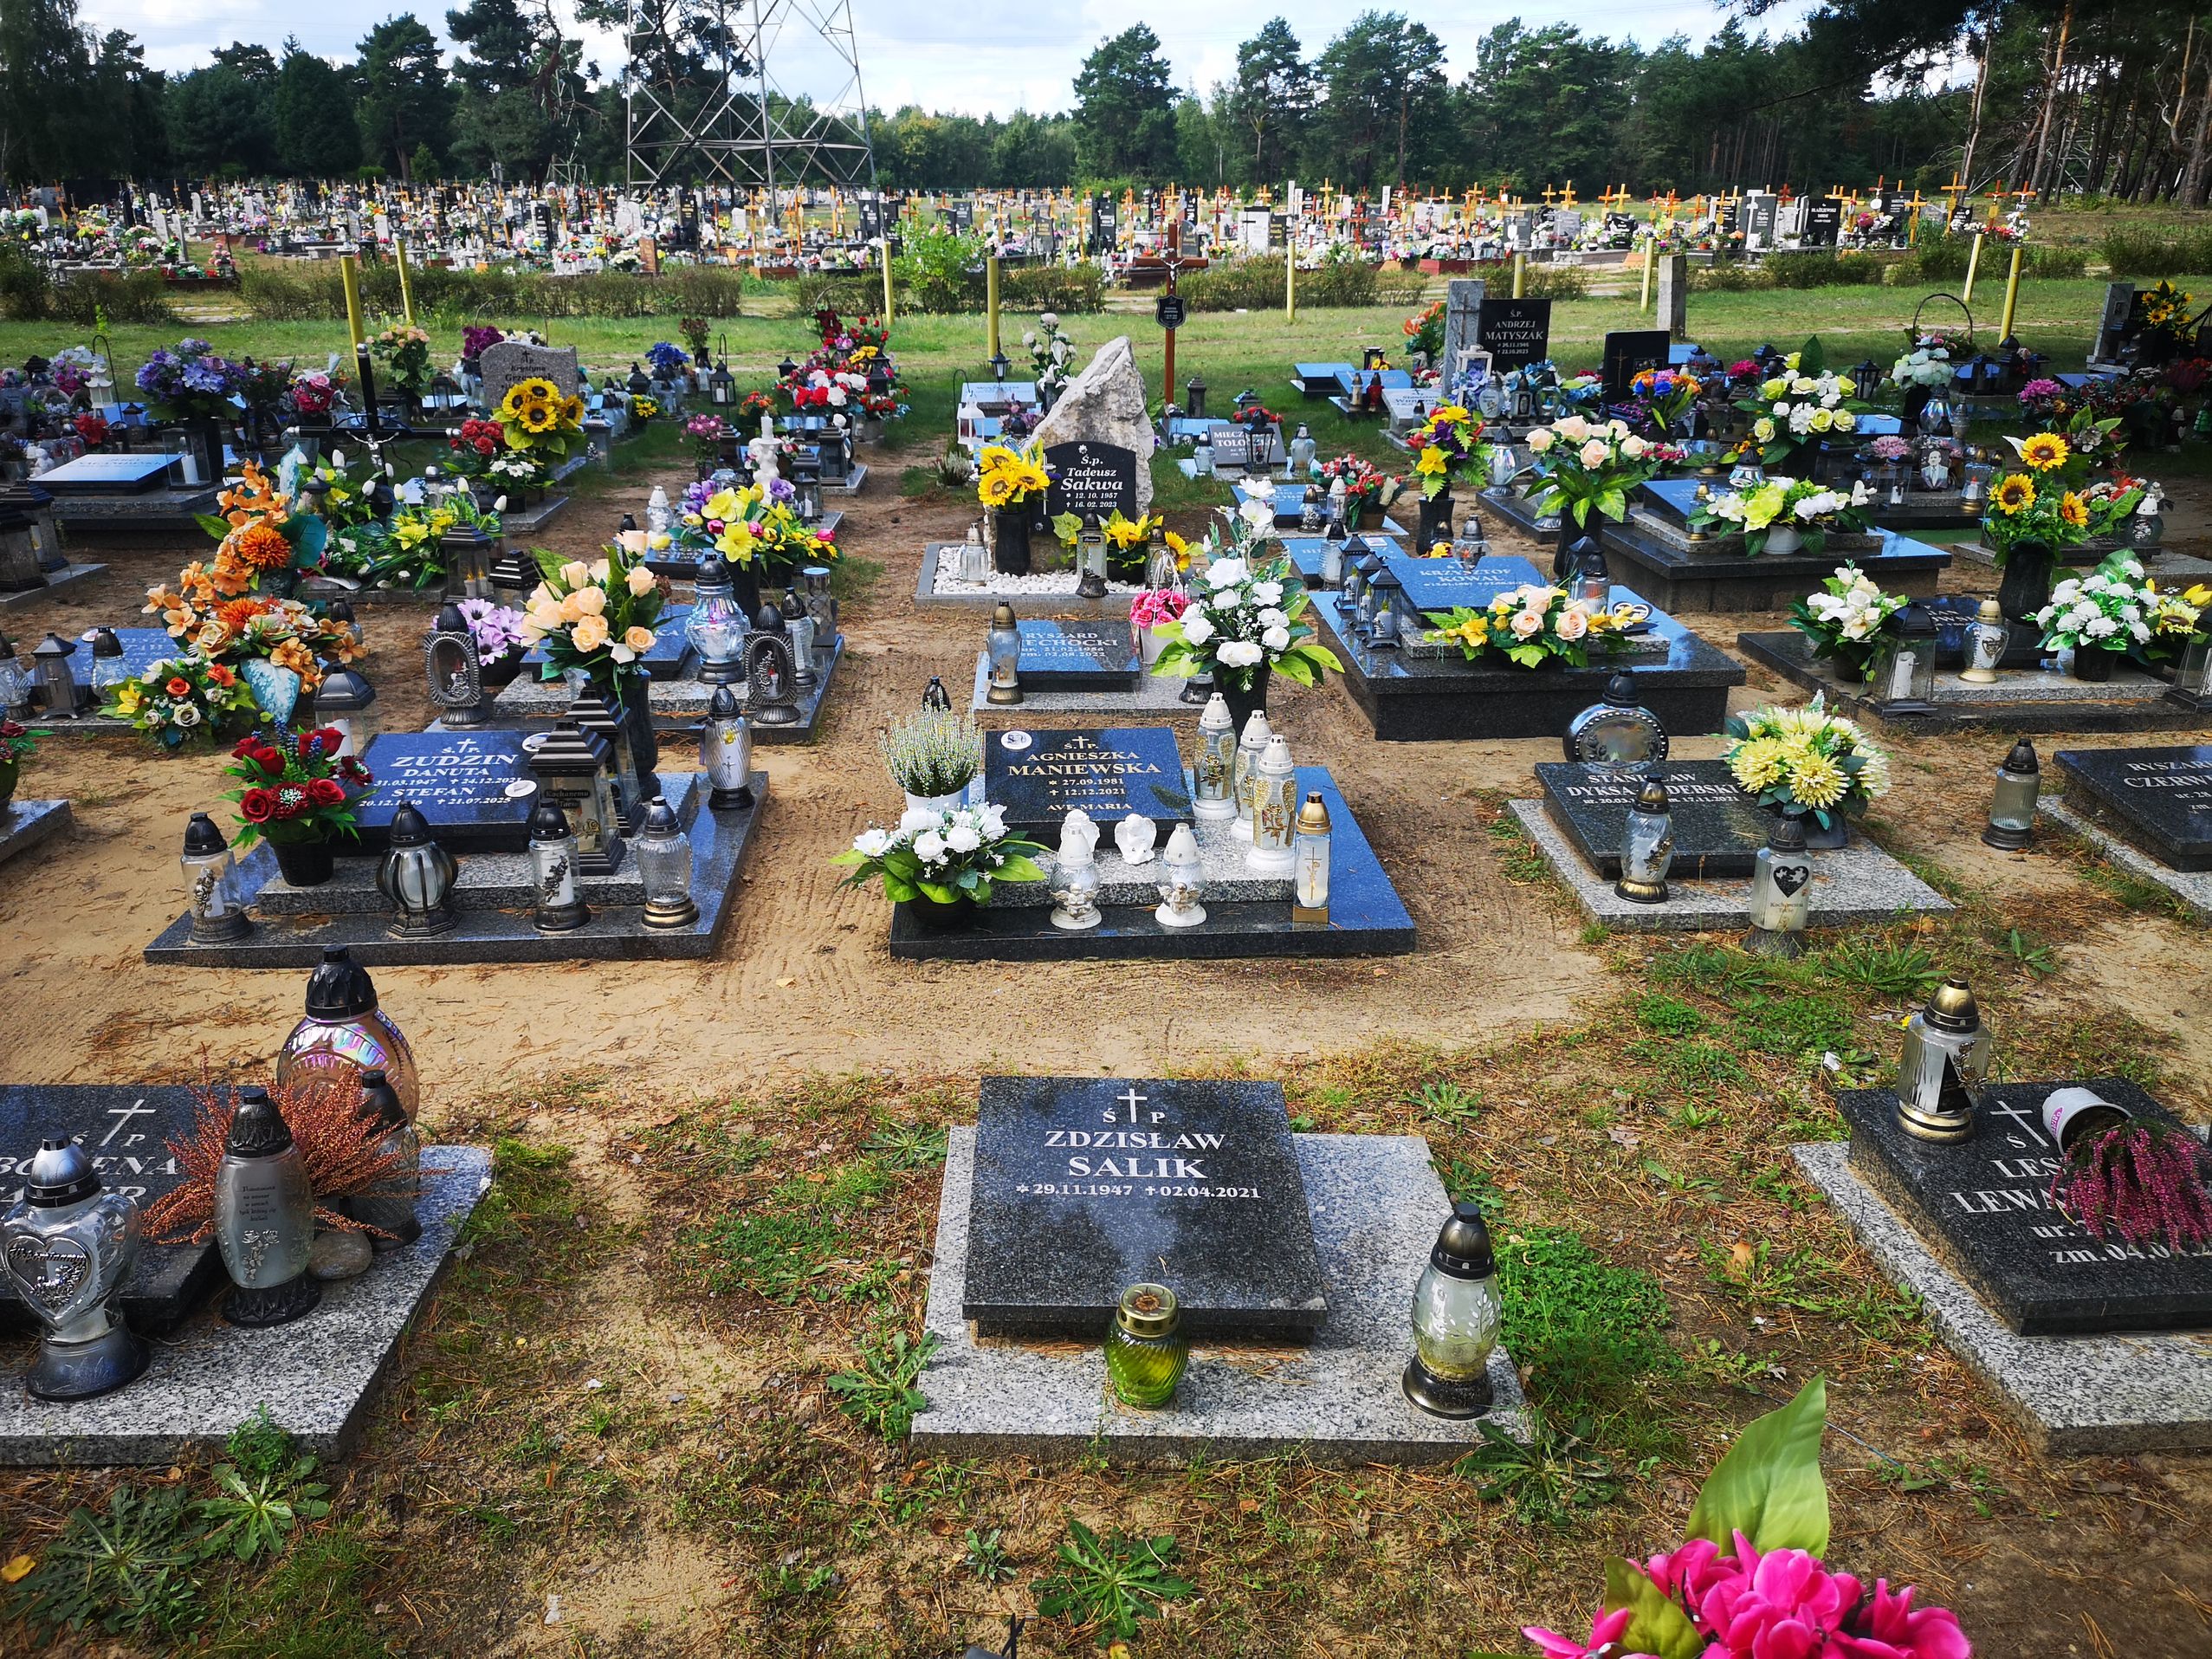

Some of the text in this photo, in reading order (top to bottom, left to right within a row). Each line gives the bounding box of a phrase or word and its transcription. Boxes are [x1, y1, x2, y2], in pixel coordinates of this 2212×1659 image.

[1485, 331, 1543, 340] MATYSZAK
[1081, 454, 1103, 466] Ś.p.
[1067, 468, 1116, 476] Tadeusz
[1060, 477, 1123, 490] Sakwa
[391, 755, 518, 767] ZUDZIN
[1026, 751, 1141, 761] AGNIESZKA
[402, 768, 490, 777] DANUTA
[1008, 762, 1161, 776] MANIEWSKA
[391, 787, 476, 797] STEFAN
[1103, 1108, 1166, 1124] Ś P
[122, 1134, 146, 1146] P
[1045, 1131, 1226, 1150] ZDZISŁAW
[1069, 1157, 1208, 1178] SALIK
[1032, 1183, 1261, 1198] 29.11.1947 02.04.2021
